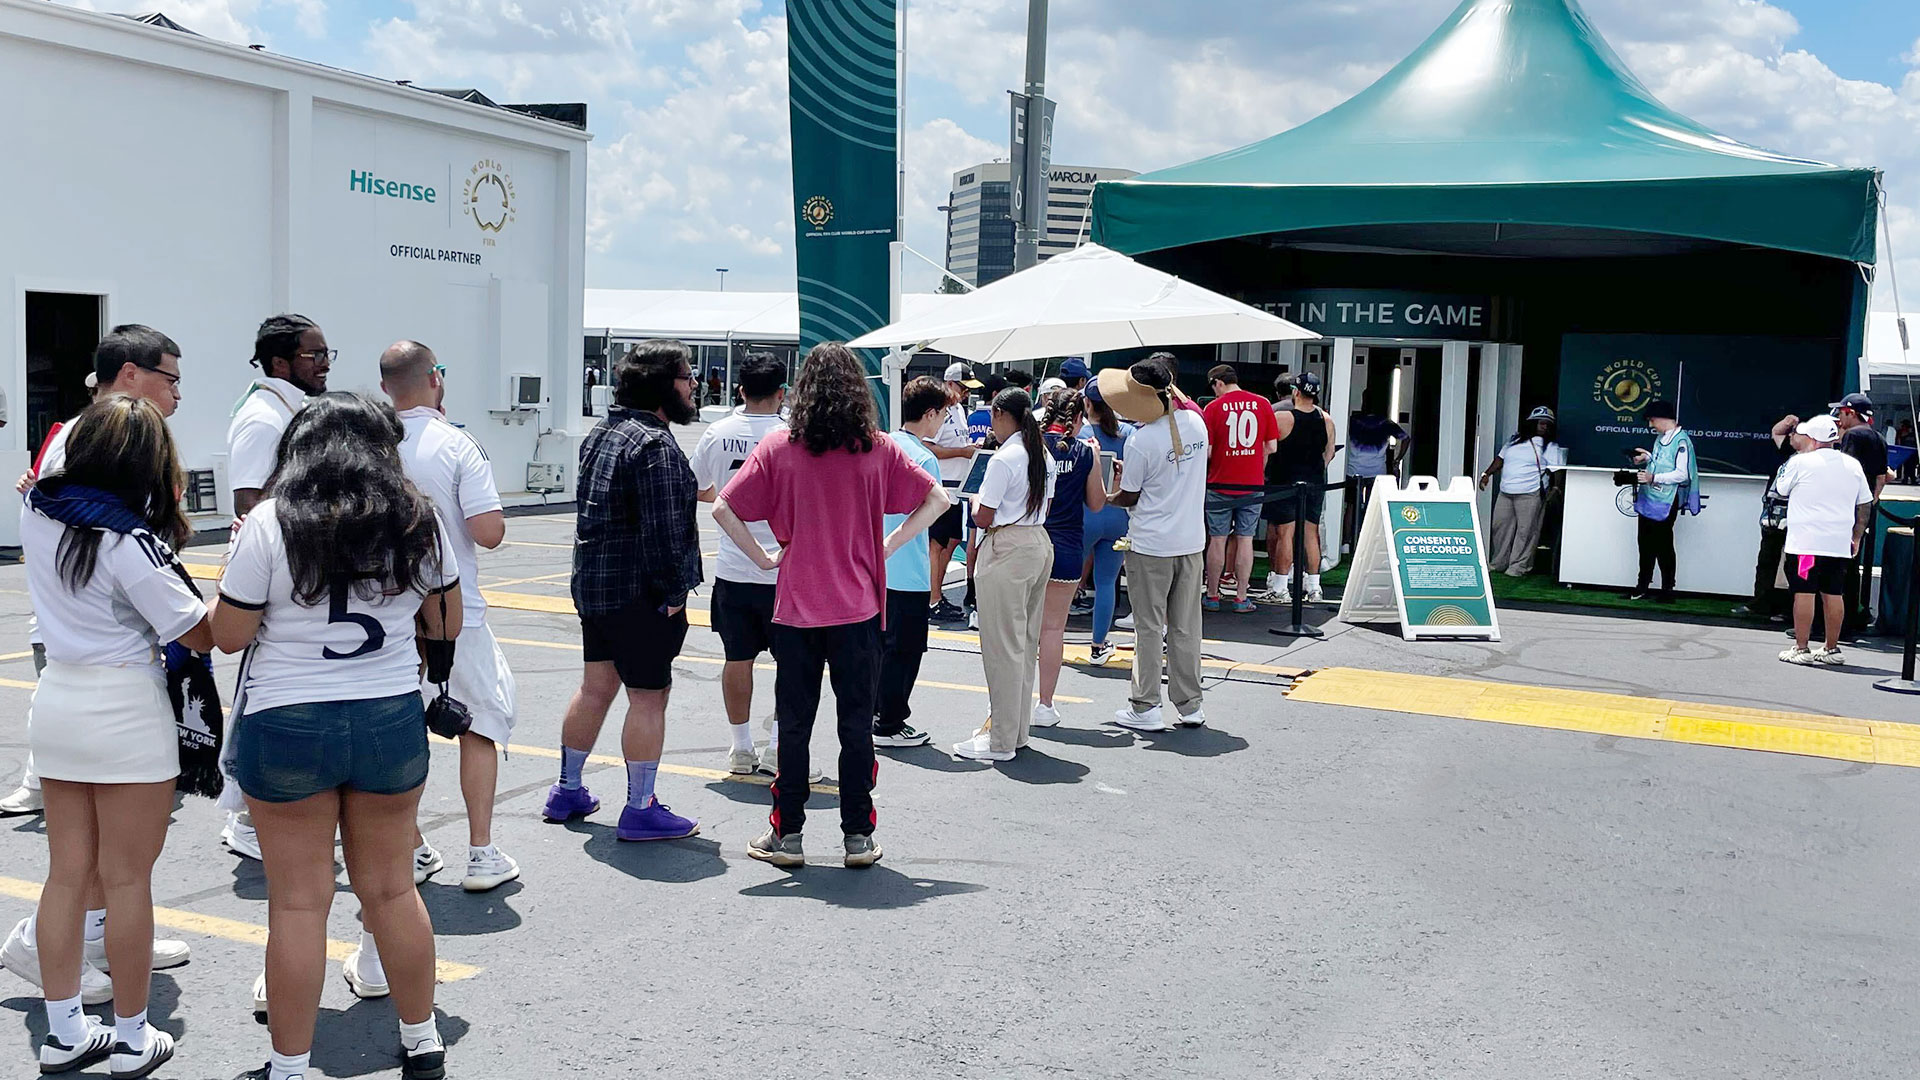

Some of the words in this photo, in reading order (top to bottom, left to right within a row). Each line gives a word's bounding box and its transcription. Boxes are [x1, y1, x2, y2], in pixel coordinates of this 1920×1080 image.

[1015, 107, 1025, 145] E
[350, 169, 436, 203] Hisense
[1049, 171, 1097, 184] MARCUM
[463, 179, 472, 215] CLUB
[471, 159, 502, 175] WORLD
[504, 174, 516, 199] CUP
[1015, 175, 1023, 210] 6
[482, 238, 496, 247] FIFA
[390, 244, 436, 260] OFFICIAL
[438, 249, 482, 265] PARTNER
[1252, 302, 1292, 319] ET
[1300, 302, 1327, 323] IN
[1336, 302, 1395, 324] THE
[1404, 303, 1483, 327] GAME
[1593, 375, 1604, 402] CLUB
[1604, 359, 1644, 373] WORLD
[1646, 367, 1662, 387] CUP
[1222, 401, 1258, 412] OLIVER
[1225, 410, 1258, 449] 10
[1595, 425, 1630, 434] OFFICIAL
[1705, 430, 1722, 438] CUP
[722, 438, 748, 453] VINI
[1192, 440, 1204, 450] PIF
[1405, 536, 1453, 545] CONSENT
[1453, 536, 1467, 546] TO
[1403, 545, 1417, 554] BE
[1419, 545, 1472, 555] RECORDED
[322, 571, 387, 660] 5
[190, 731, 216, 748] YORK
